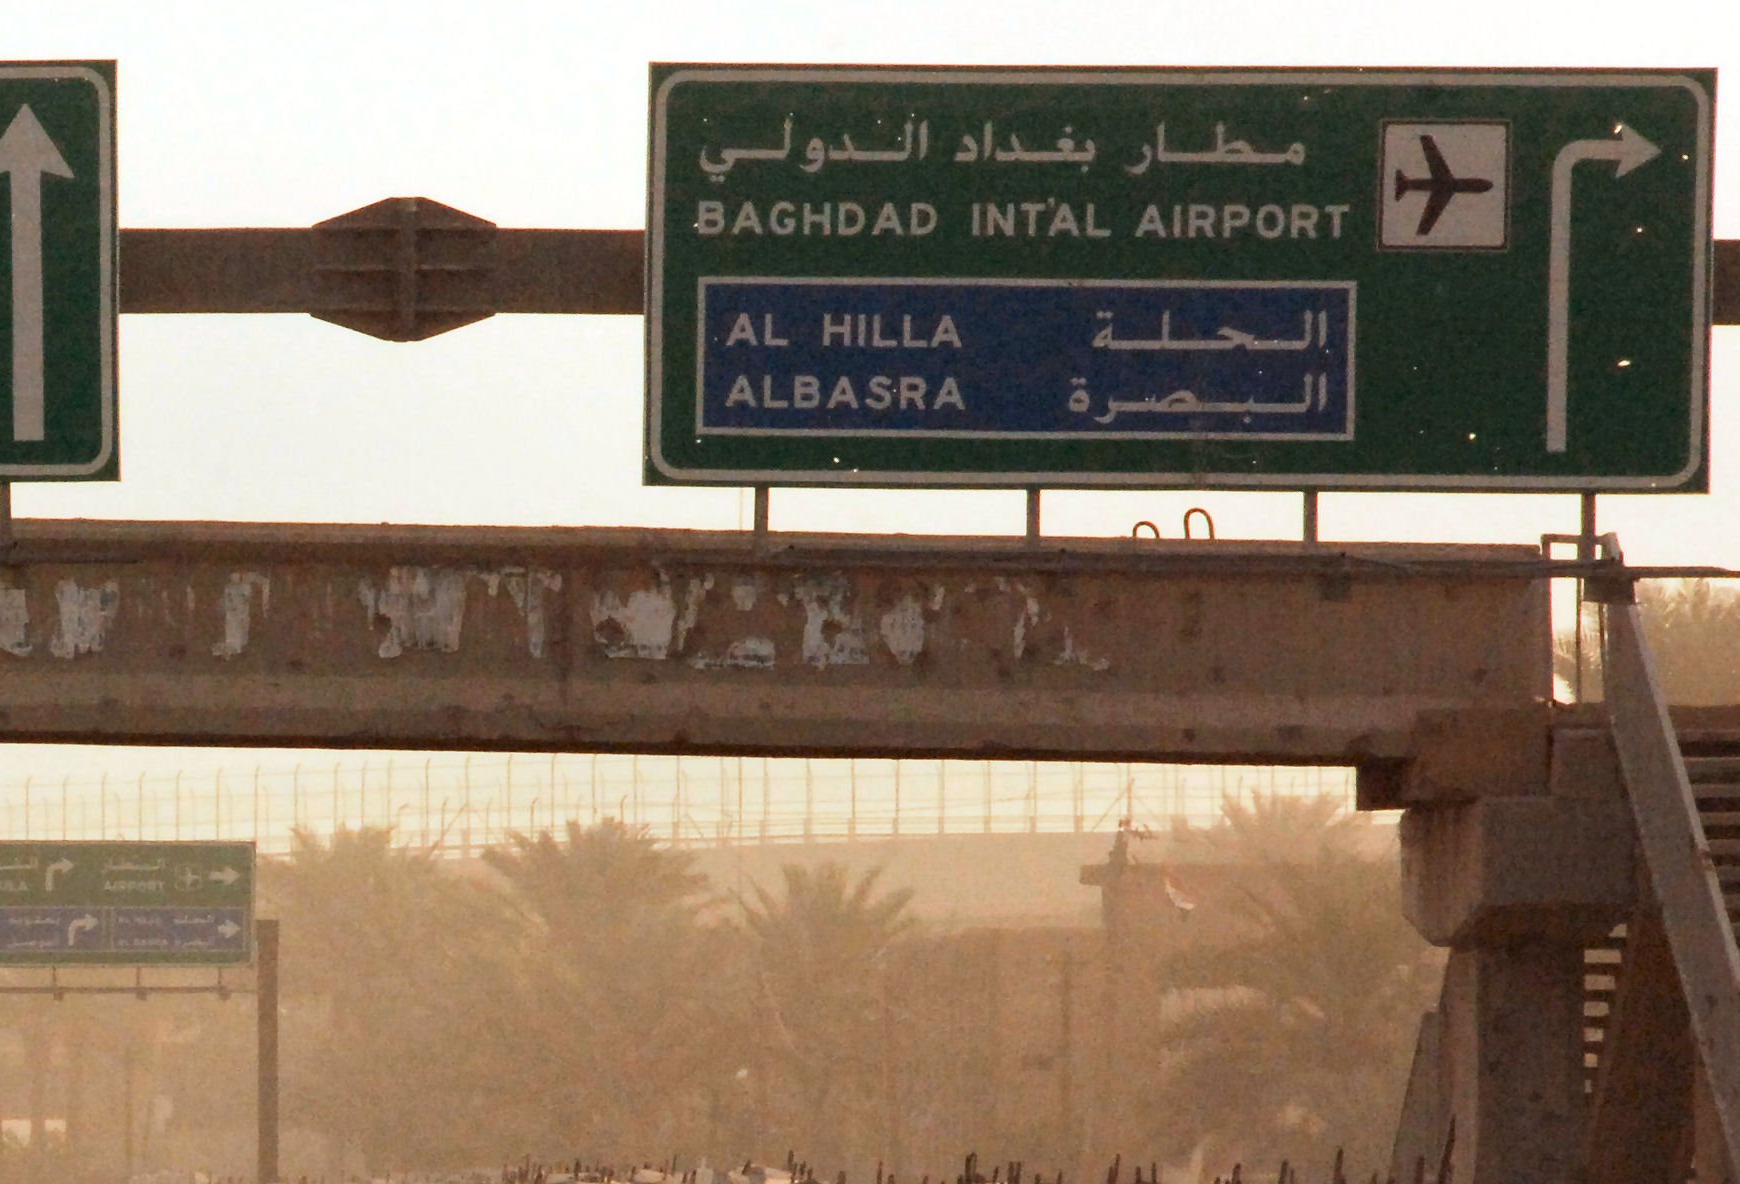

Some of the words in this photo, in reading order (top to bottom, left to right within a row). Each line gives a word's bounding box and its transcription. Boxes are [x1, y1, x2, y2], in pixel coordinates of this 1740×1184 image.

[699, 117, 929, 183] الدولي
[954, 121, 1097, 174] بغداد
[1124, 122, 1306, 175] مطار
[696, 200, 938, 236] BAGHDAD
[1135, 203, 1350, 239] AIRPORT
[725, 312, 789, 347] AL
[822, 313, 962, 348] HILLA
[1091, 310, 1328, 351] الحلة
[725, 374, 965, 410] ALBASRA
[1067, 373, 1328, 424] البصرة
[103, 880, 164, 892] AIRPORT
